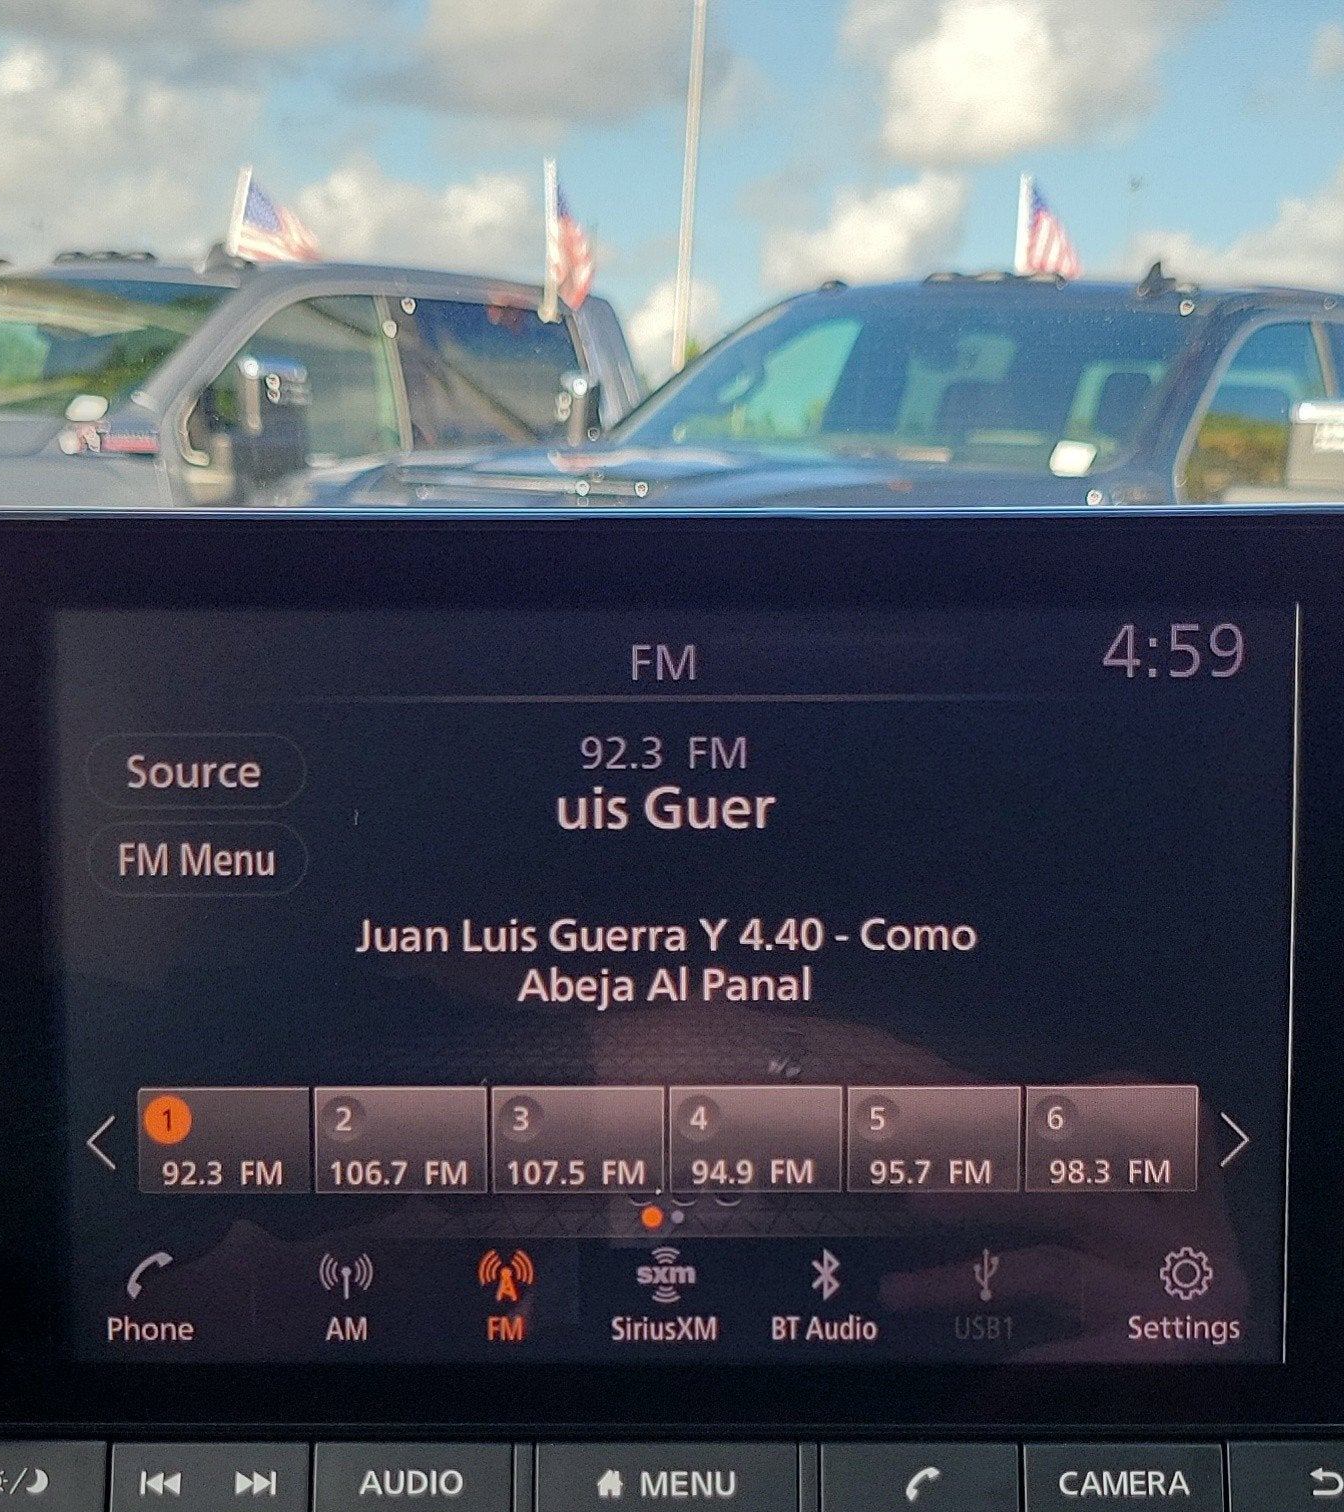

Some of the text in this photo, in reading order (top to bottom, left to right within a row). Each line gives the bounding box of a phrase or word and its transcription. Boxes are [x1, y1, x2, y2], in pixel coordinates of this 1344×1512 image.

[1103, 623, 1243, 677] 4:59
[632, 645, 694, 680] FM
[581, 737, 745, 769] 92.3 FM
[128, 755, 260, 788] Source
[558, 786, 775, 829] uis Guer
[120, 843, 274, 875] FM Menu
[356, 920, 448, 952] Juan
[464, 919, 537, 951] Luis
[550, 919, 685, 951] Guerra
[700, 919, 727, 951] Y
[740, 918, 823, 950] 4.40
[861, 918, 976, 950] Como
[518, 966, 810, 1010] Abeja Al Panal
[161, 1109, 173, 1131] 1
[336, 1107, 351, 1131] 2
[513, 1107, 529, 1130] 3
[690, 1106, 707, 1129] 4
[870, 1107, 885, 1130] 5
[1047, 1107, 1063, 1130] 6
[163, 1161, 282, 1185] 92.3 FM
[331, 1161, 467, 1185] 106.7 FM
[509, 1160, 644, 1185] 107.5 FM
[692, 1160, 813, 1184] 94.9 FM
[871, 1160, 990, 1184] 95.7 FM
[1050, 1160, 1170, 1183] 98.3 FM
[637, 1265, 696, 1285] sxm
[108, 1316, 193, 1340] Phone
[326, 1317, 367, 1340] AM
[489, 1316, 524, 1340] FM
[612, 1317, 716, 1340] SiriusXM
[772, 1315, 877, 1340] BT Audio
[955, 1316, 1012, 1340] USB1
[1129, 1315, 1239, 1344] Settings
[360, 1470, 463, 1495] AUDIO
[641, 1471, 735, 1496] MENU
[1060, 1471, 1189, 1495] CAMERA
